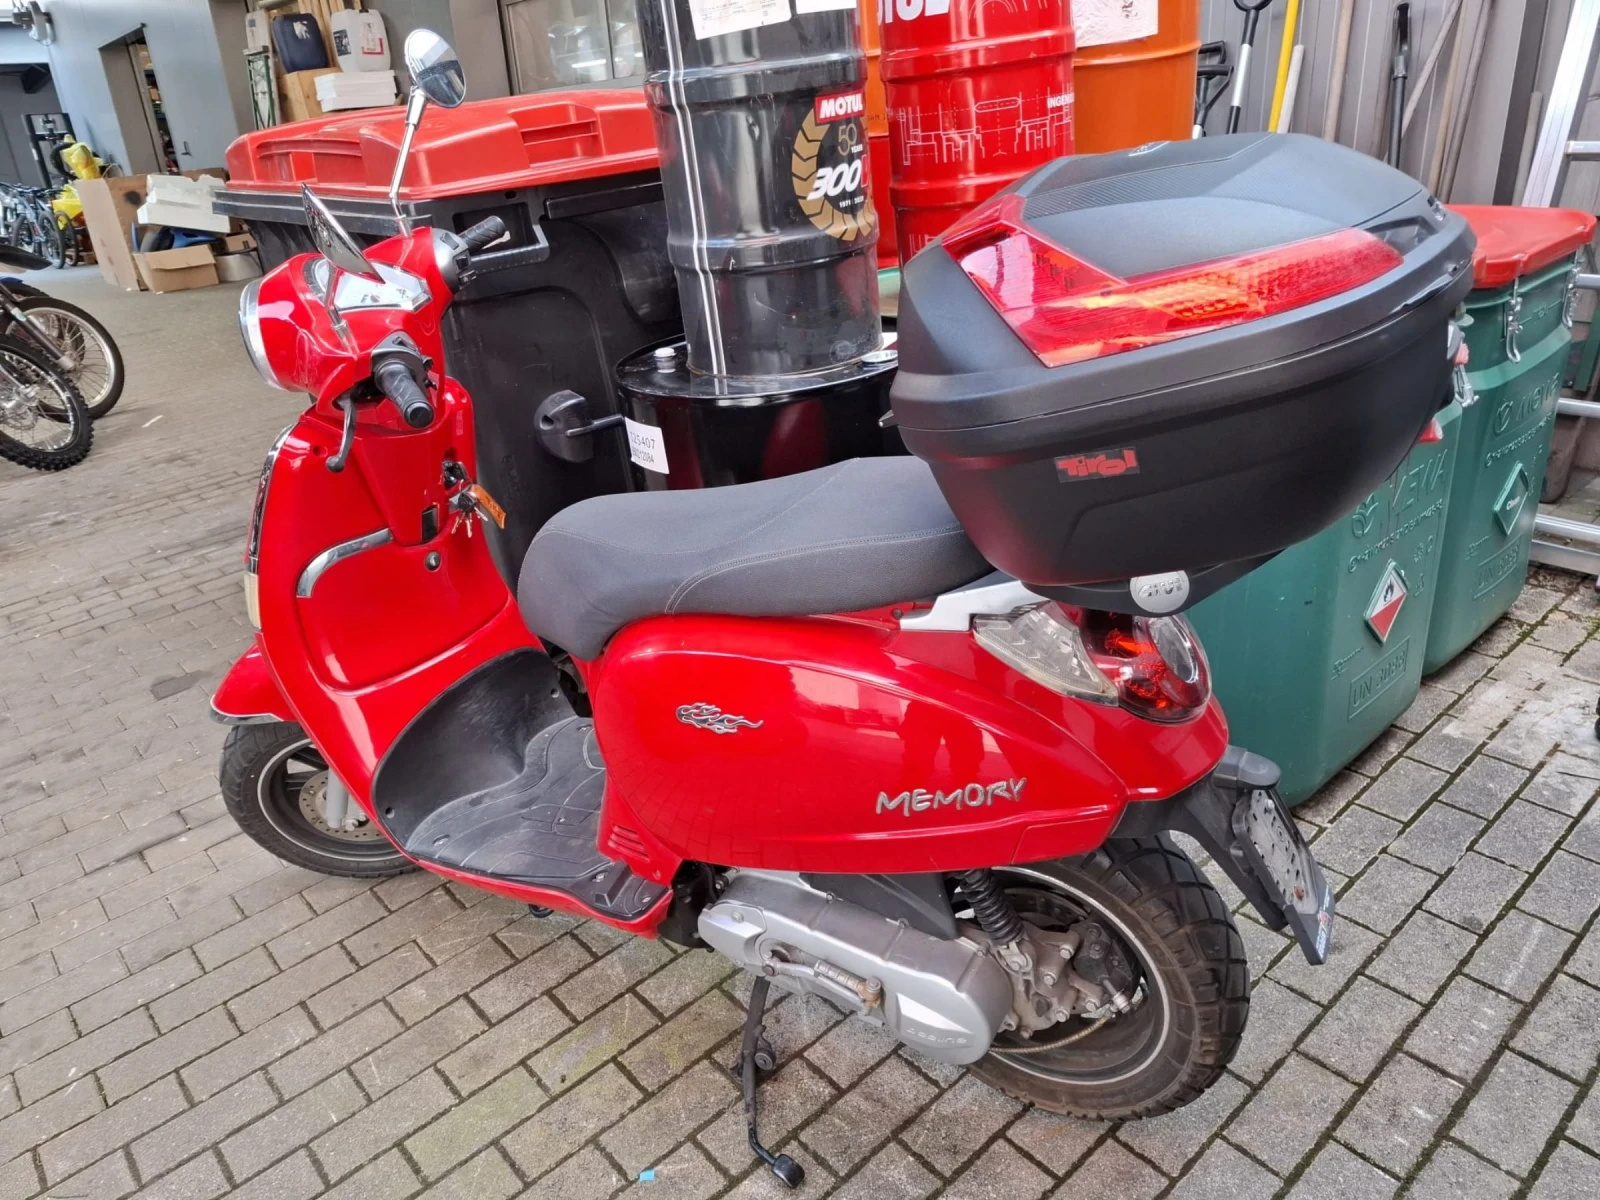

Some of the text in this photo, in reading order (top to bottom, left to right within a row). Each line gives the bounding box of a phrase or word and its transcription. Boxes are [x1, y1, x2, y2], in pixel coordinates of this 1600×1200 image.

[819, 93, 863, 119] MOTUL
[1057, 449, 1137, 477] Tirol
[875, 777, 1028, 817] MEMORY
